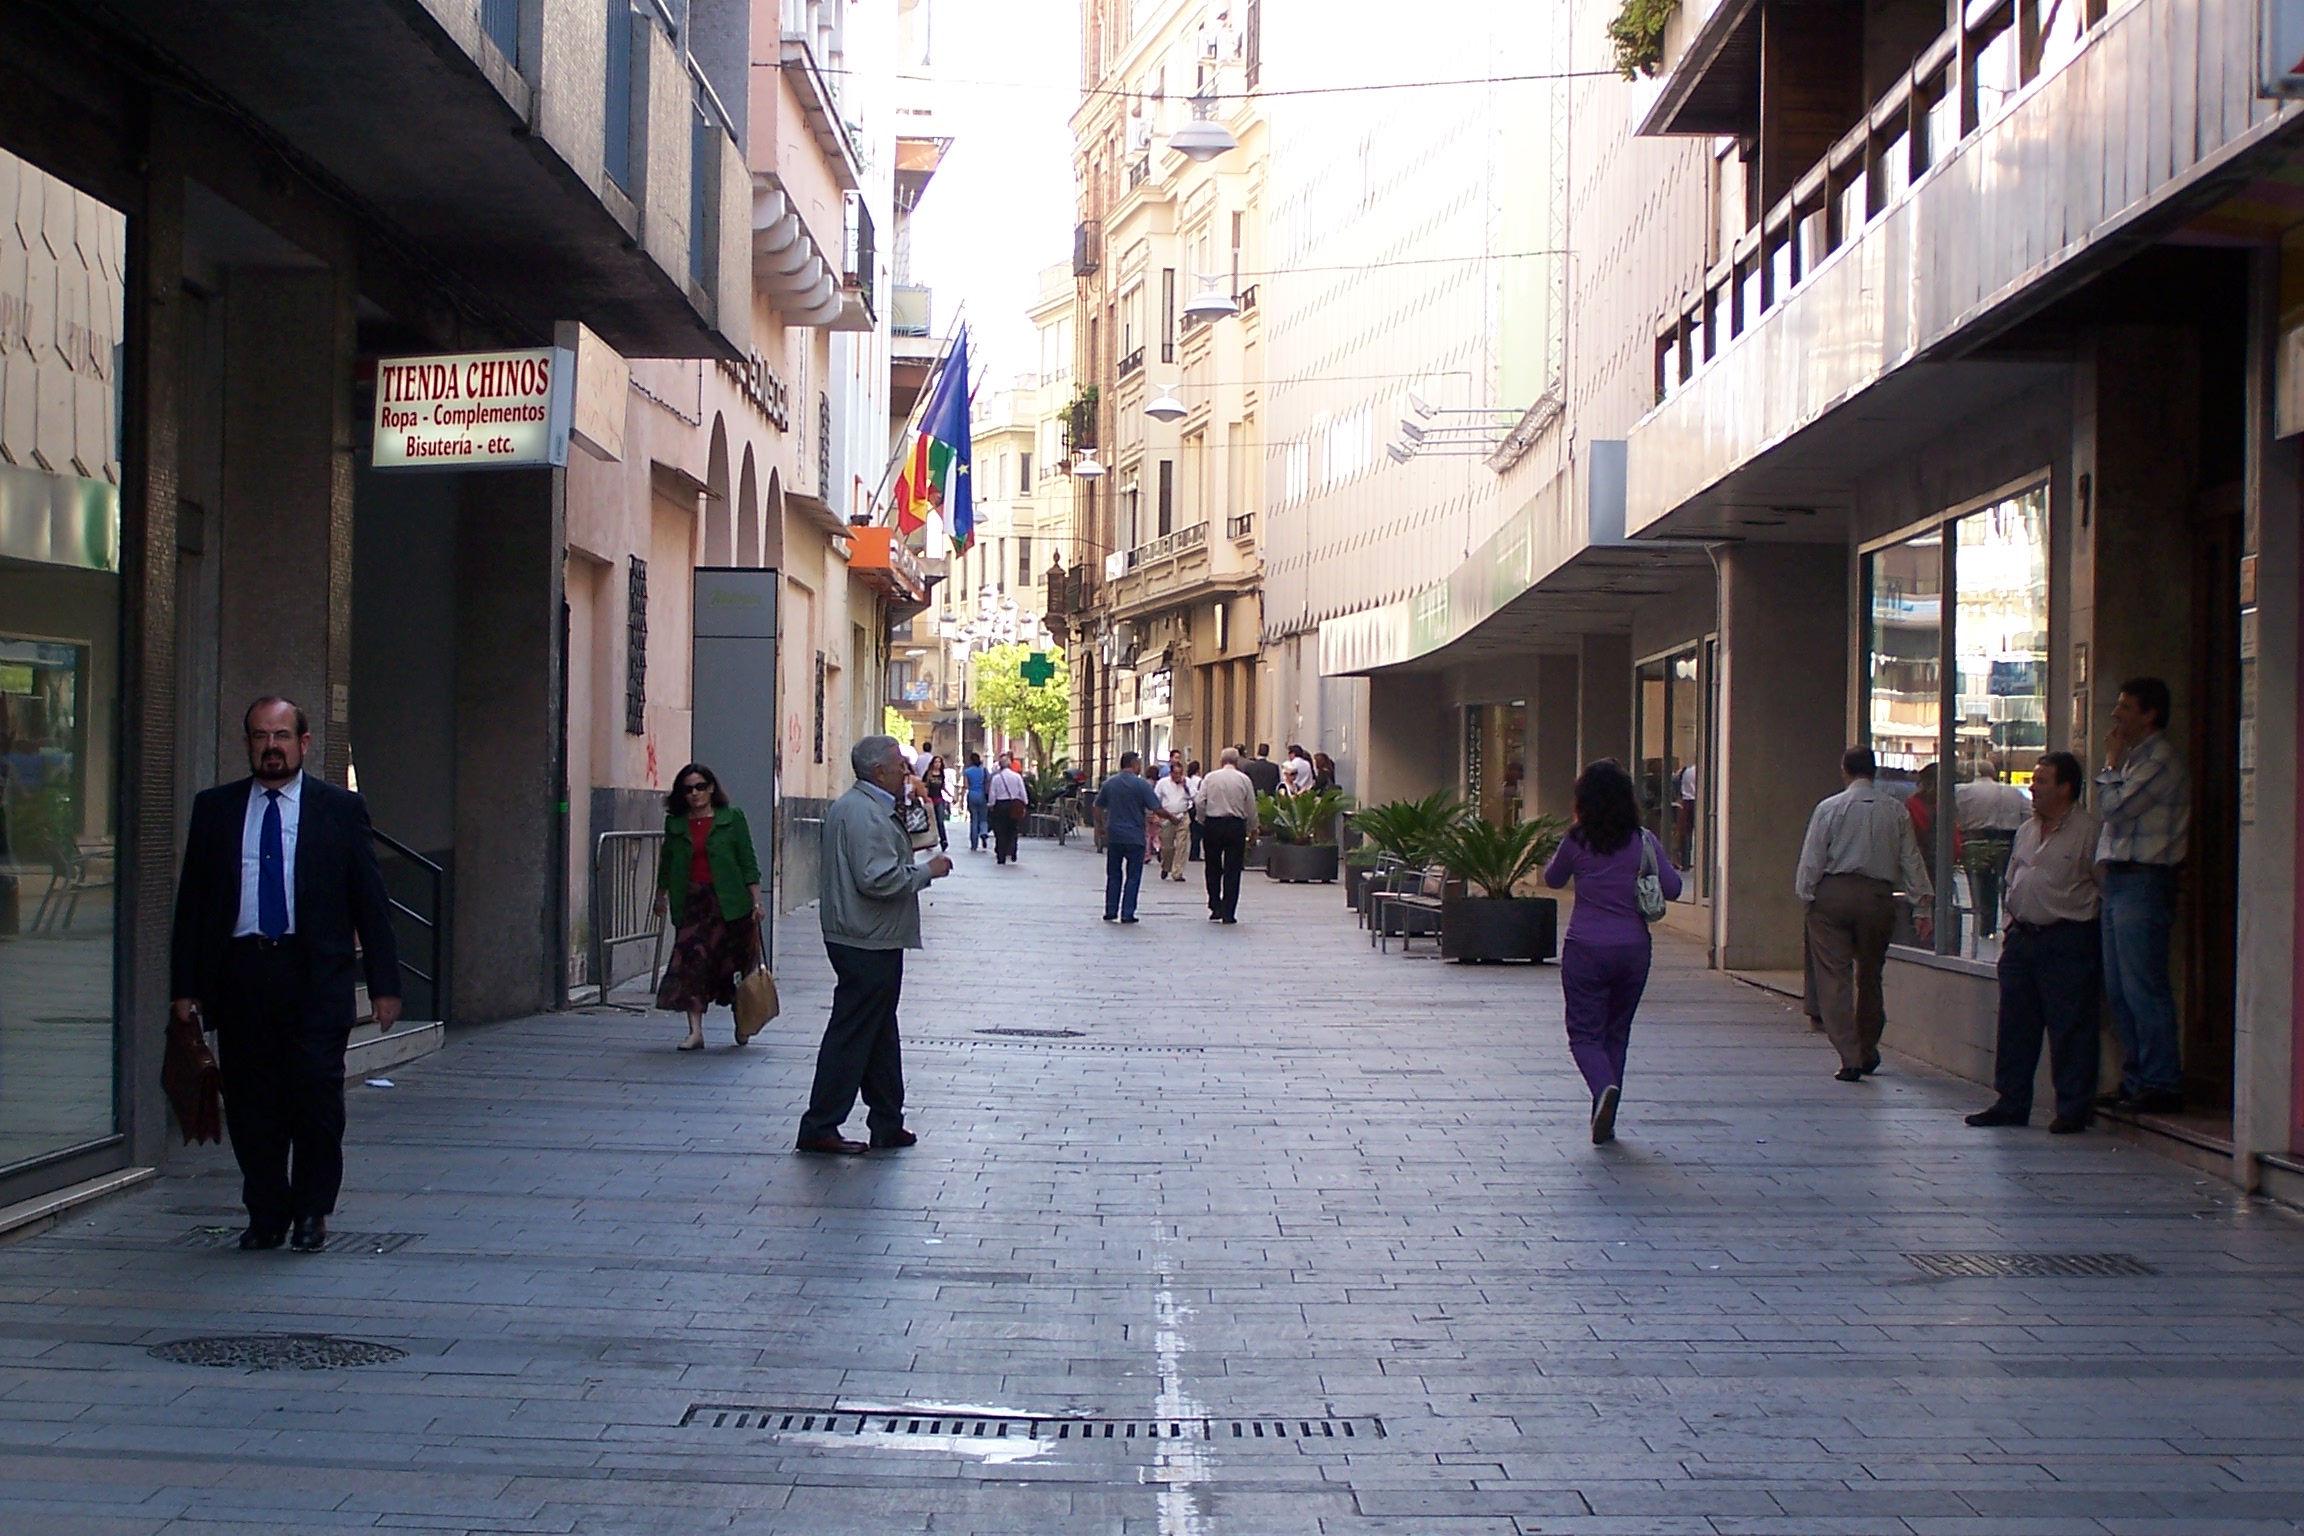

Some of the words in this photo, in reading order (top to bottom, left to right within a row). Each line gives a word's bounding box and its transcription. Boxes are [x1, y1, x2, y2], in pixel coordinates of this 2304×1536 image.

[383, 364, 459, 402] TIENDA
[465, 357, 550, 399] CHINOS
[382, 407, 417, 433] Ropa
[433, 402, 545, 430] Complementos
[406, 433, 472, 458] Bisutería
[488, 435, 515, 454] etc.
